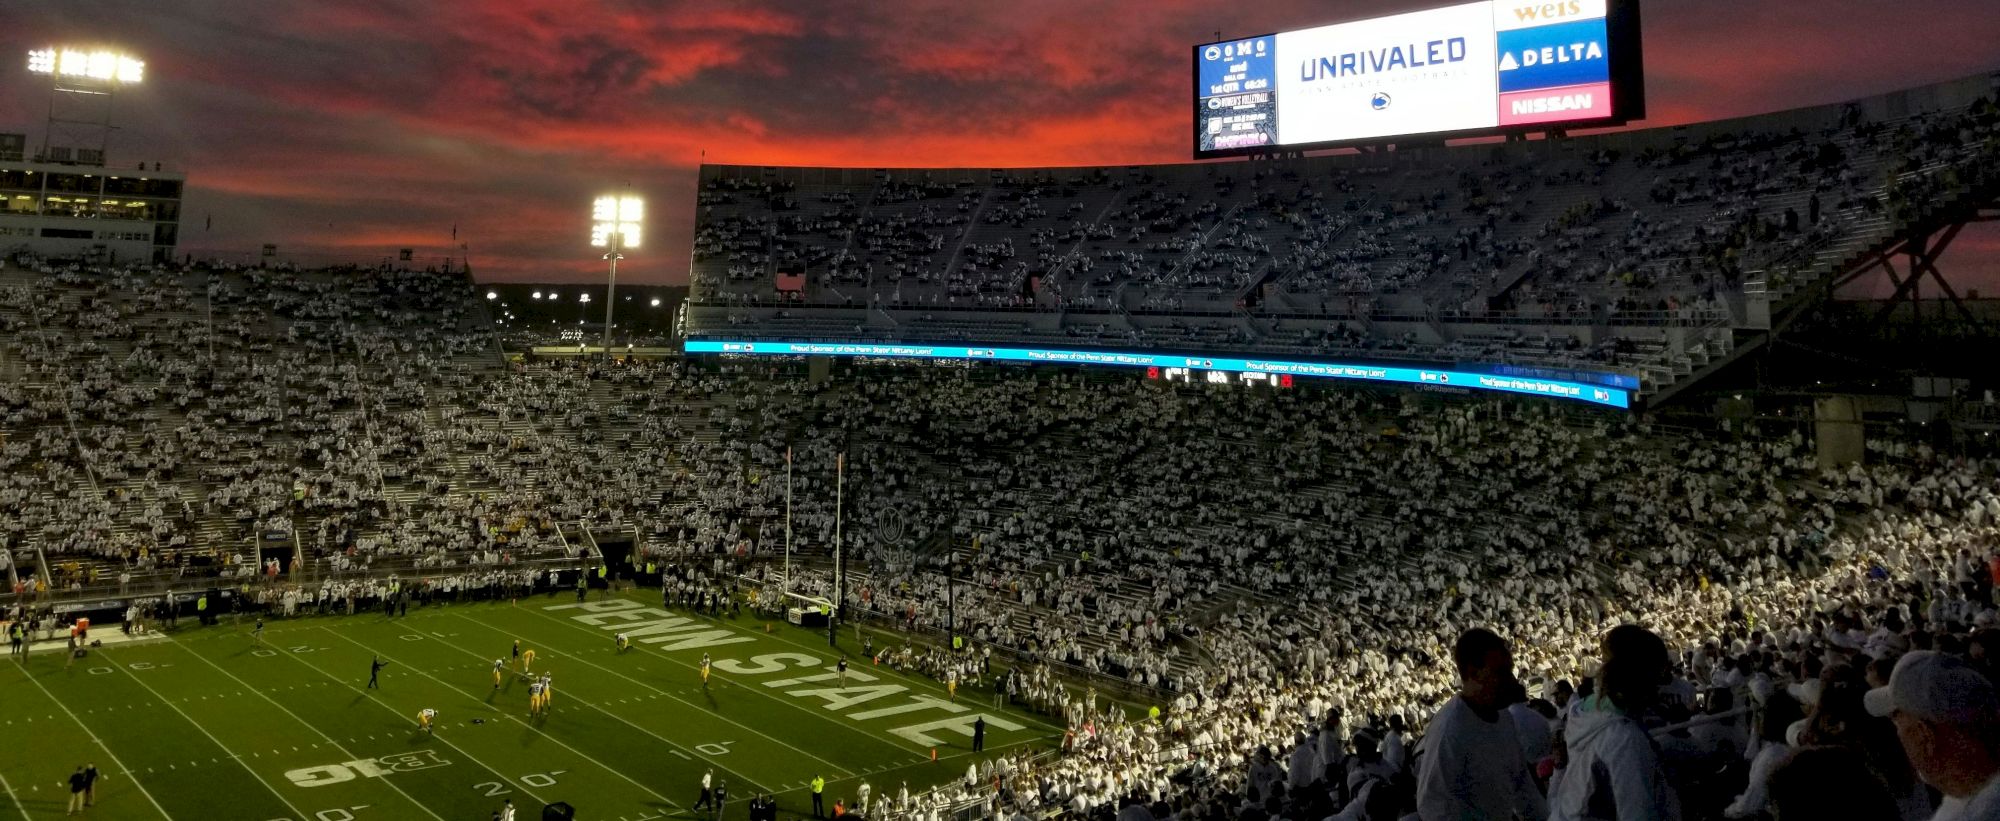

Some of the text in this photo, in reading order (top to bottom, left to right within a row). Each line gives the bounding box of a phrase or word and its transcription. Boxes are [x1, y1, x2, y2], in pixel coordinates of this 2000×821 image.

[1513, 0, 1581, 21] weis
[1237, 41, 1252, 56] M
[1523, 41, 1602, 67] DELTA
[1301, 36, 1466, 82] UNRIVALED
[1223, 82, 1239, 93] QTR
[1512, 94, 1592, 115] NISSAN
[811, 345, 835, 353] Sponsor
[892, 347, 914, 355] Nittany
[1046, 352, 1068, 360] Sponsor
[1116, 355, 1137, 364] Nittany
[1246, 362, 1263, 370] Proud
[1264, 363, 1288, 372] Sponsor
[1309, 365, 1325, 373] Penn
[1345, 367, 1367, 377] Nittany
[542, 599, 1027, 748] PENN STATE
[668, 743, 731, 761] 10
[472, 773, 557, 797] 20
